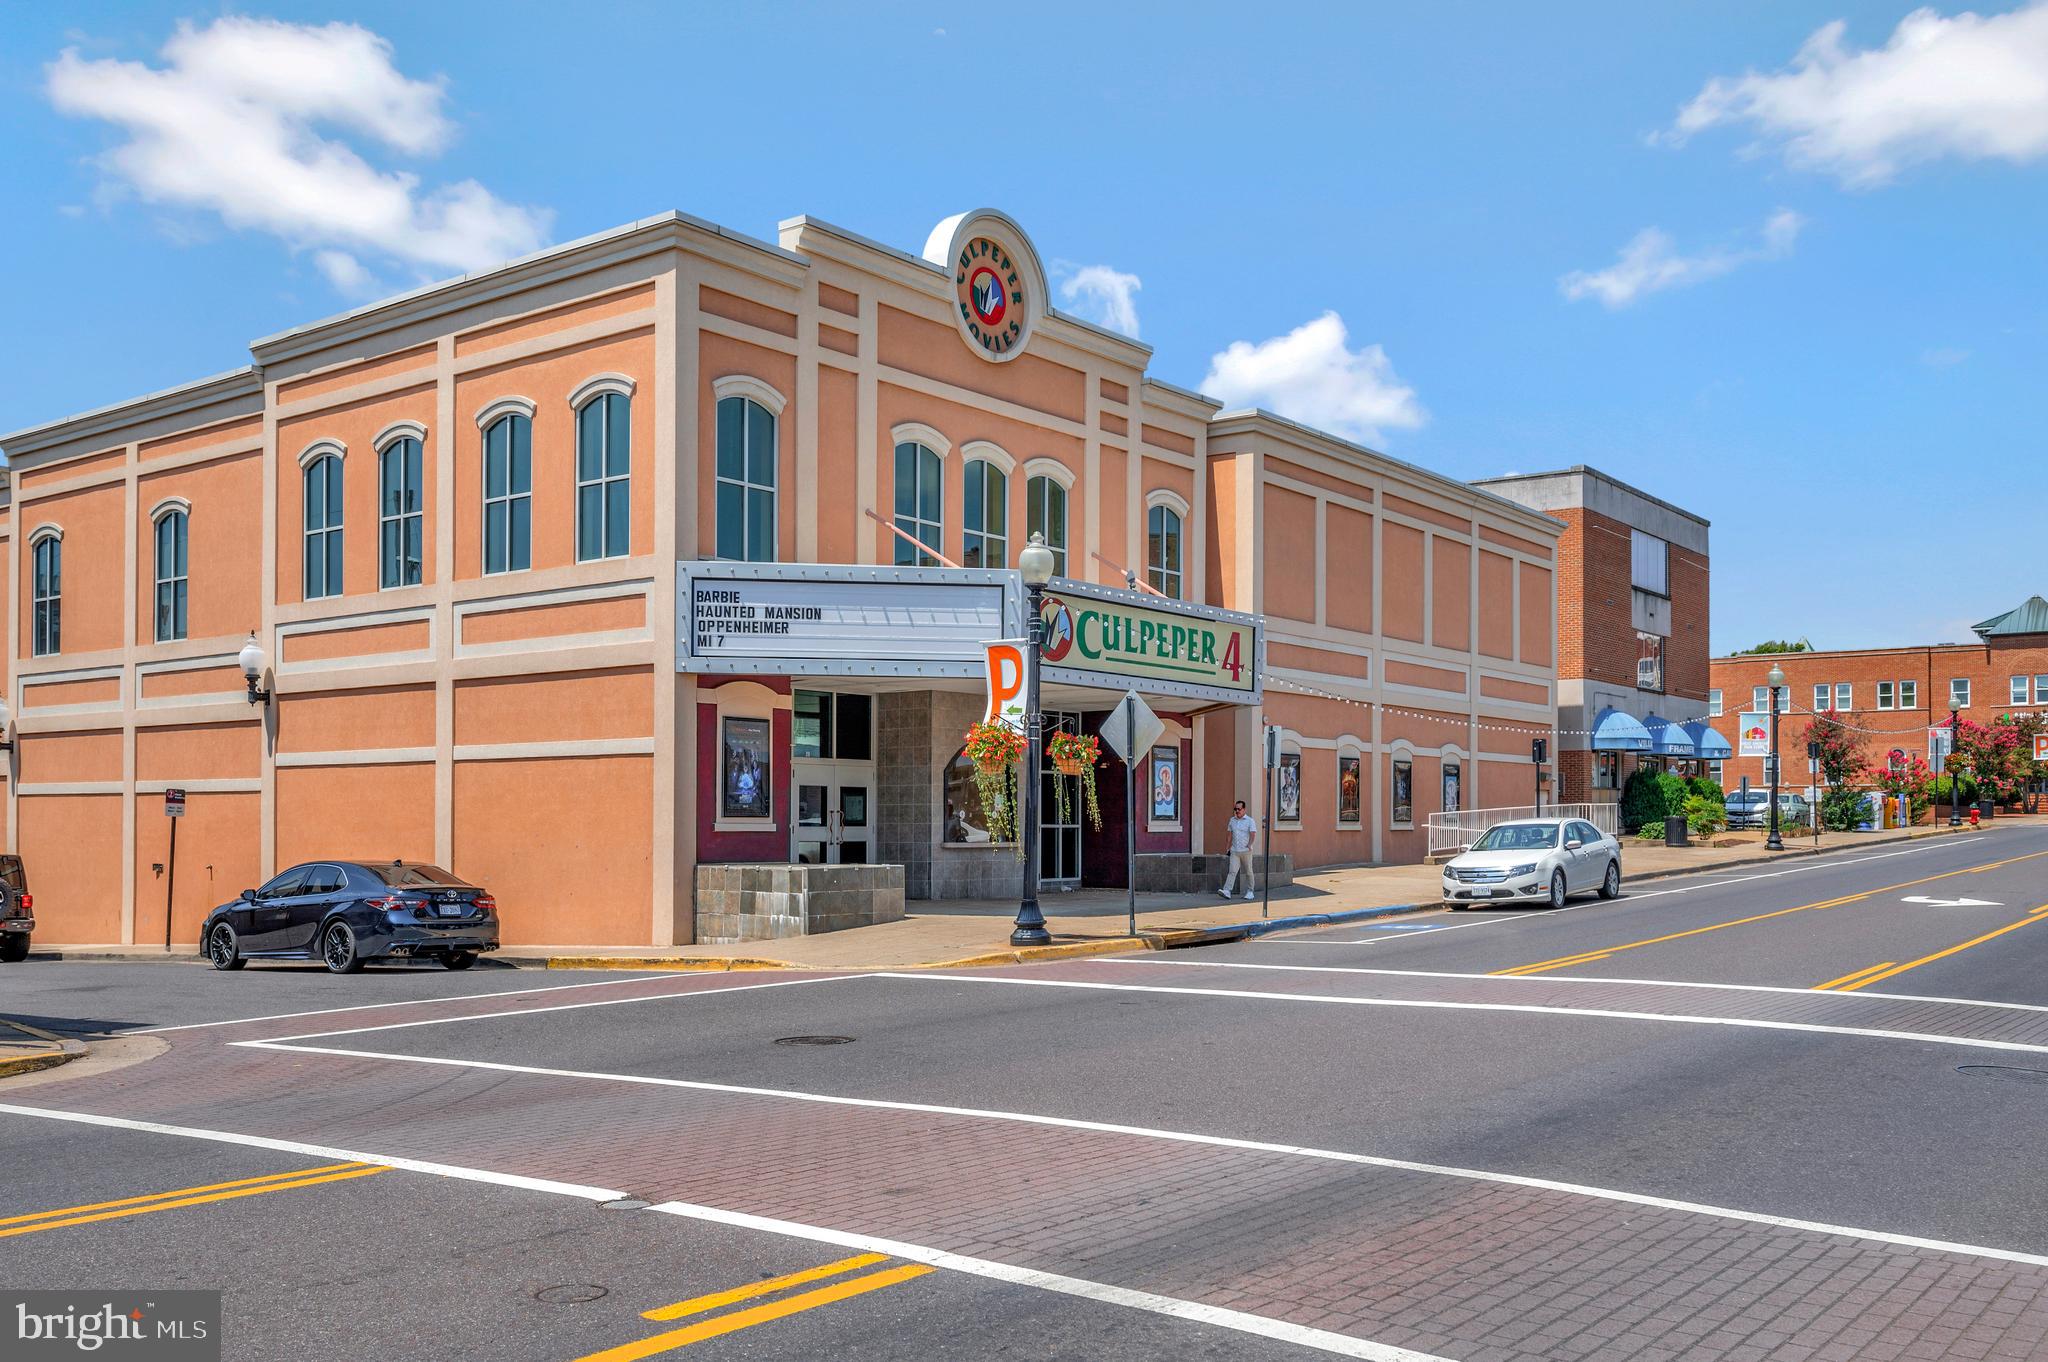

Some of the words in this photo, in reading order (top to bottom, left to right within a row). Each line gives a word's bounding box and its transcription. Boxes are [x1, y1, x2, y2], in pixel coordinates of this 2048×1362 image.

[956, 240, 1022, 305] CULPEPER
[960, 302, 1020, 352] MOVIES
[696, 591, 740, 604] BARBIE
[696, 605, 755, 619] HAUNTED
[764, 607, 822, 620] MANSION
[697, 635, 712, 648] MI
[717, 635, 725, 648] 7
[698, 620, 789, 634] OPPENHEIMER
[1221, 631, 1245, 682] 4
[988, 645, 1023, 727] P
